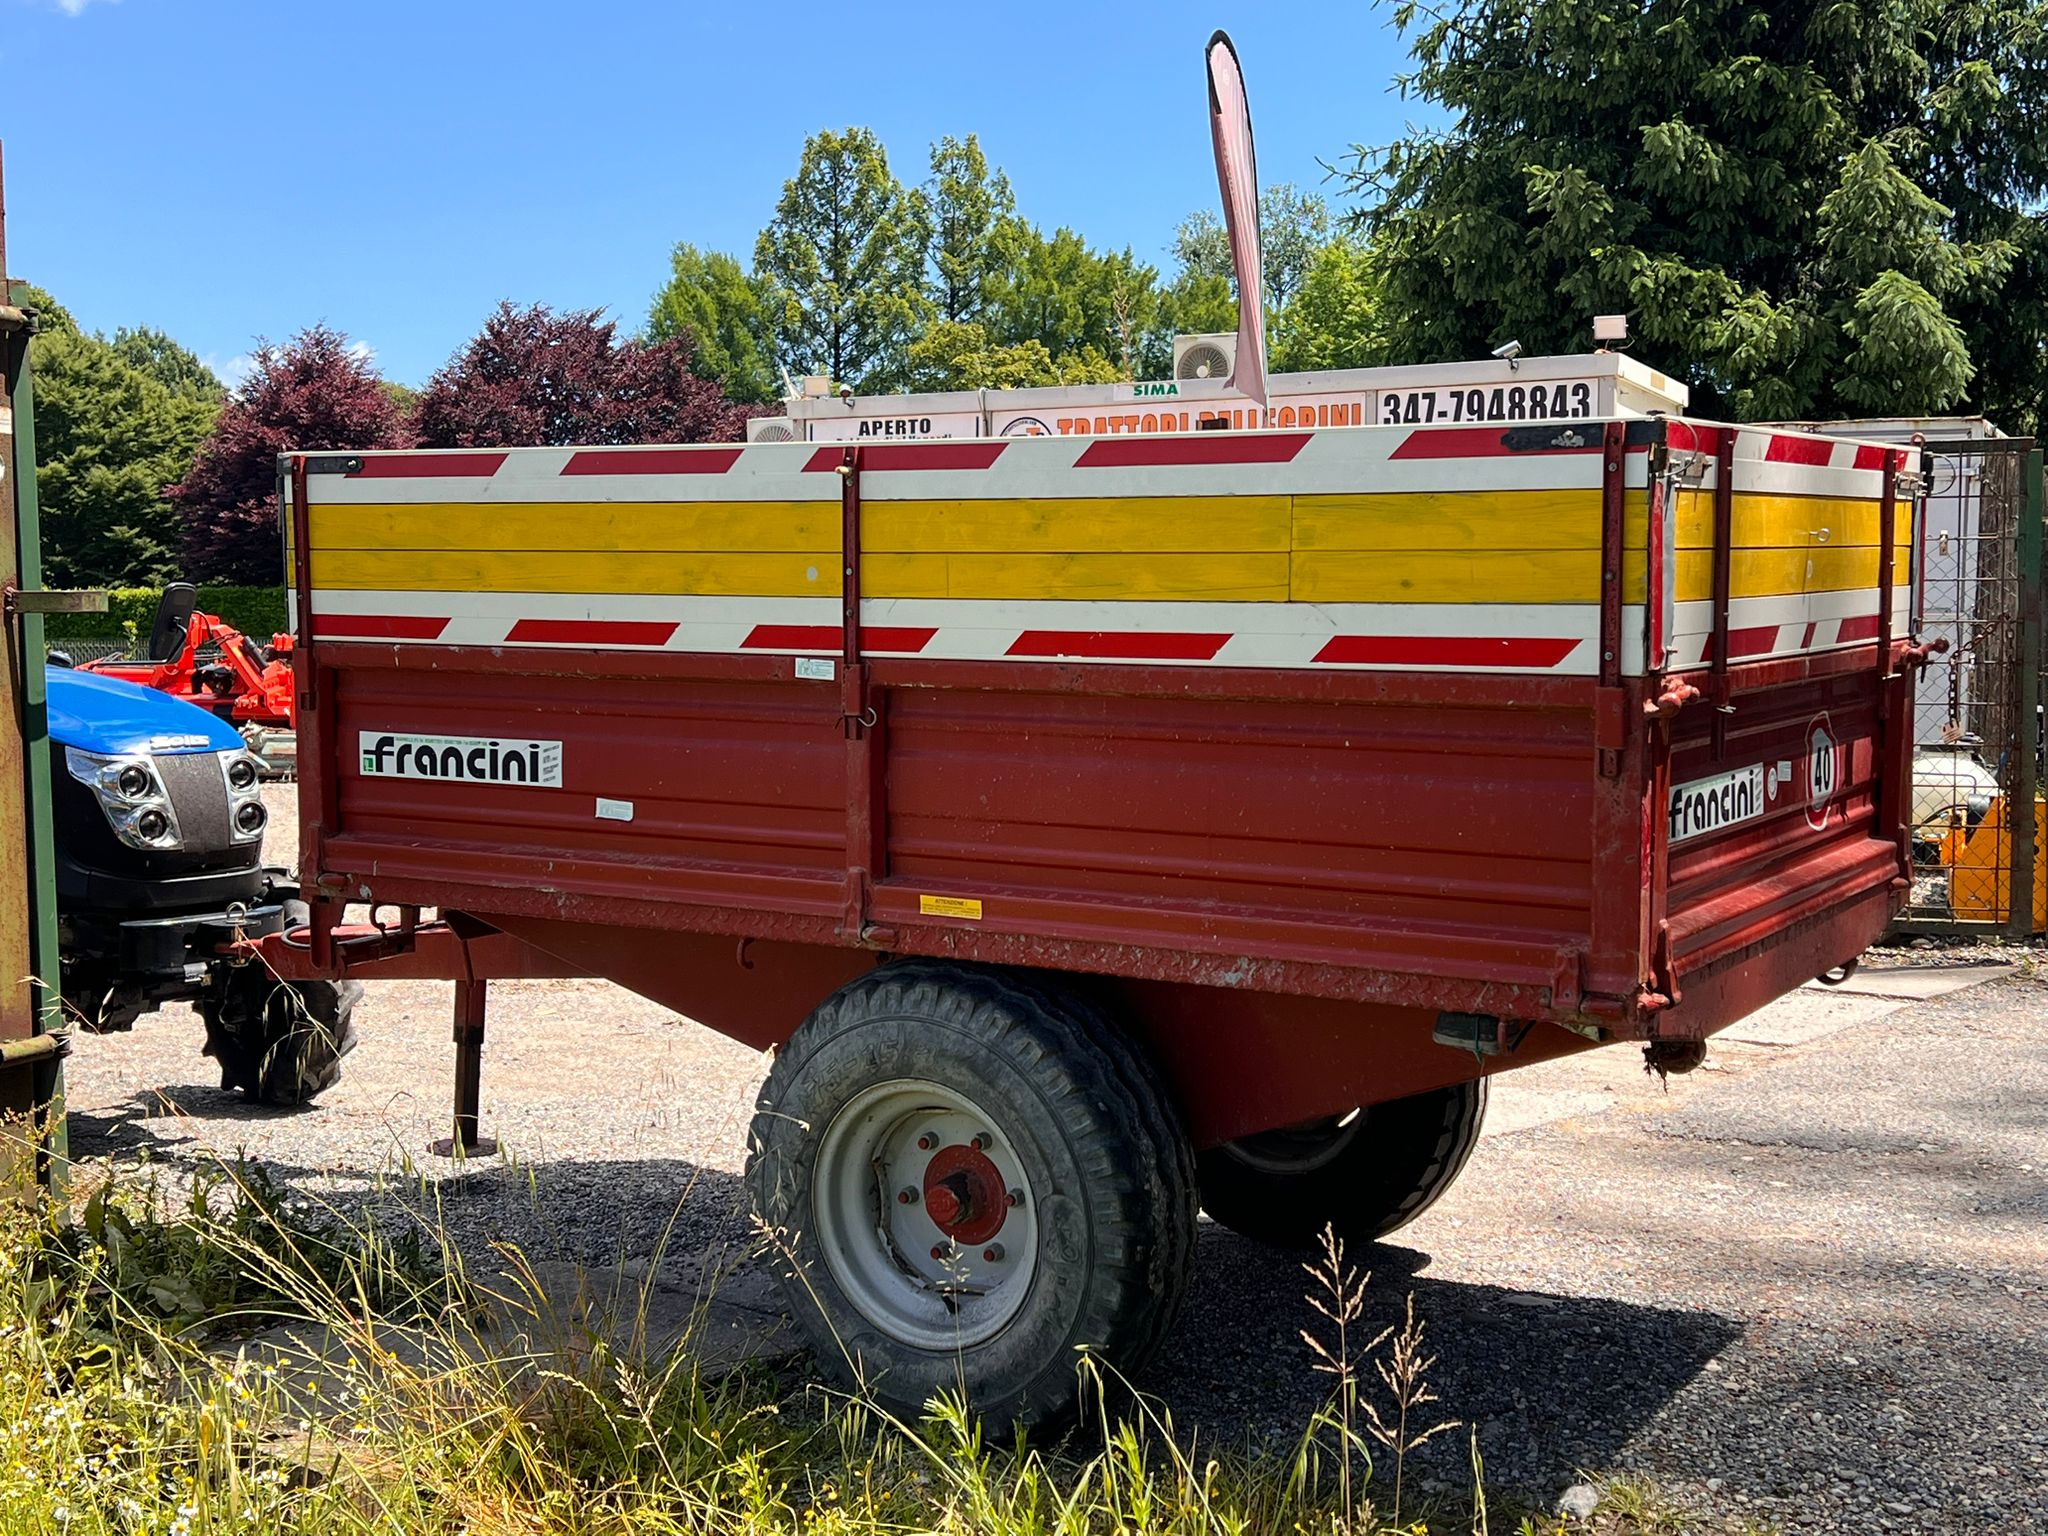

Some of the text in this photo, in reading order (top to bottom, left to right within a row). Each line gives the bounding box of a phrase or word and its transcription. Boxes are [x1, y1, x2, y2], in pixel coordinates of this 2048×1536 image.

[1134, 383, 1179, 396] SIMA
[1383, 382, 1591, 424] 347-7948843
[858, 418, 931, 436] APERTO
[362, 735, 541, 783] francini
[1814, 745, 1831, 792] 40
[1668, 768, 1755, 838] francini
